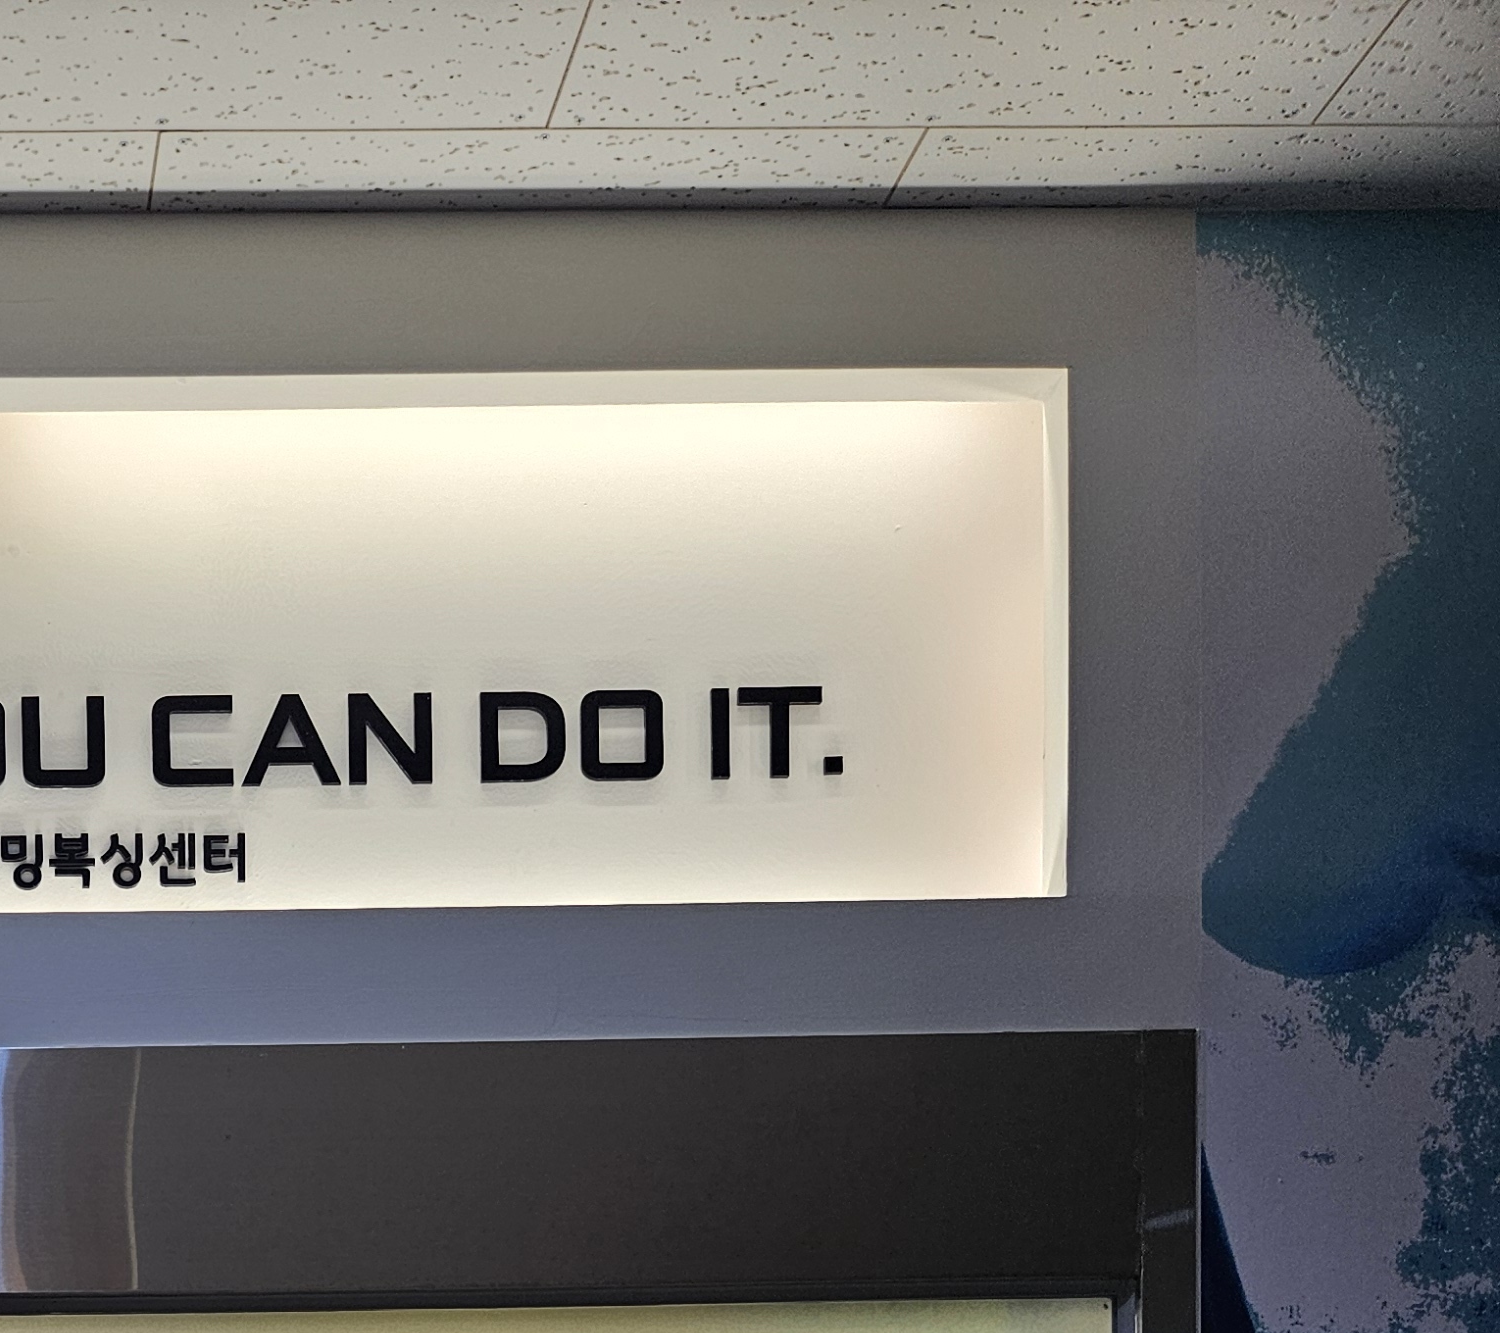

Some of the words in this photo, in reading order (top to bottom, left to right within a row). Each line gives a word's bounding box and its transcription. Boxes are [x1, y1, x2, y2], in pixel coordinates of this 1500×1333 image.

[151, 692, 434, 788] CAN
[479, 689, 665, 784] DO
[710, 685, 844, 780] IT.
